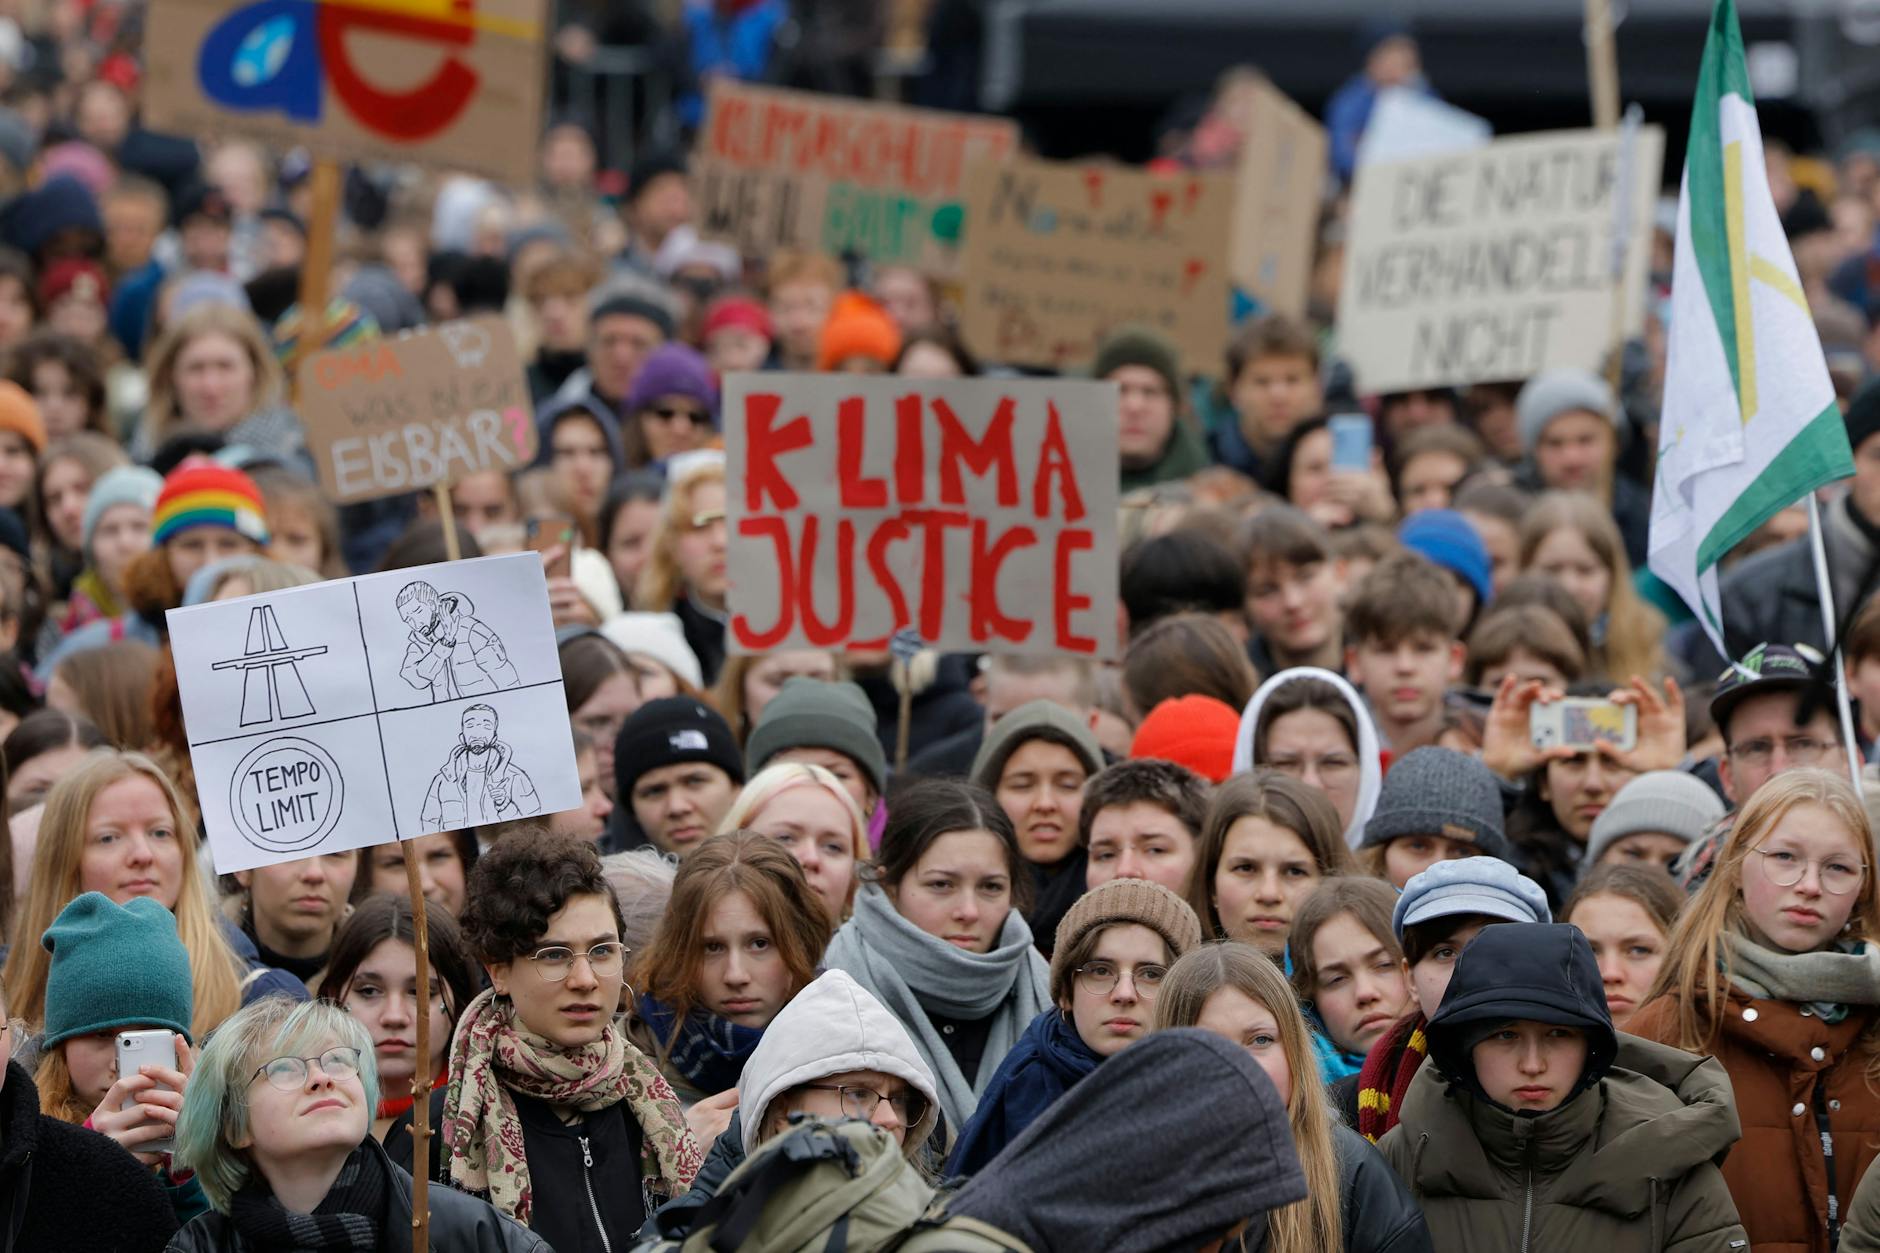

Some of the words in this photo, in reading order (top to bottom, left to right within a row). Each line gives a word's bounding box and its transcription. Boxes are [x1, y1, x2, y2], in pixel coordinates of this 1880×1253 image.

[1357, 221, 1616, 310] VERHANDEL
[313, 343, 405, 391] OMA
[1407, 302, 1562, 380] NICHT
[330, 404, 531, 497] EISBÄR?
[744, 393, 1086, 522] KLIMA
[731, 511, 1098, 655] JUSTICE
[249, 761, 321, 795] TEMPO
[255, 791, 319, 833] LIMIT
